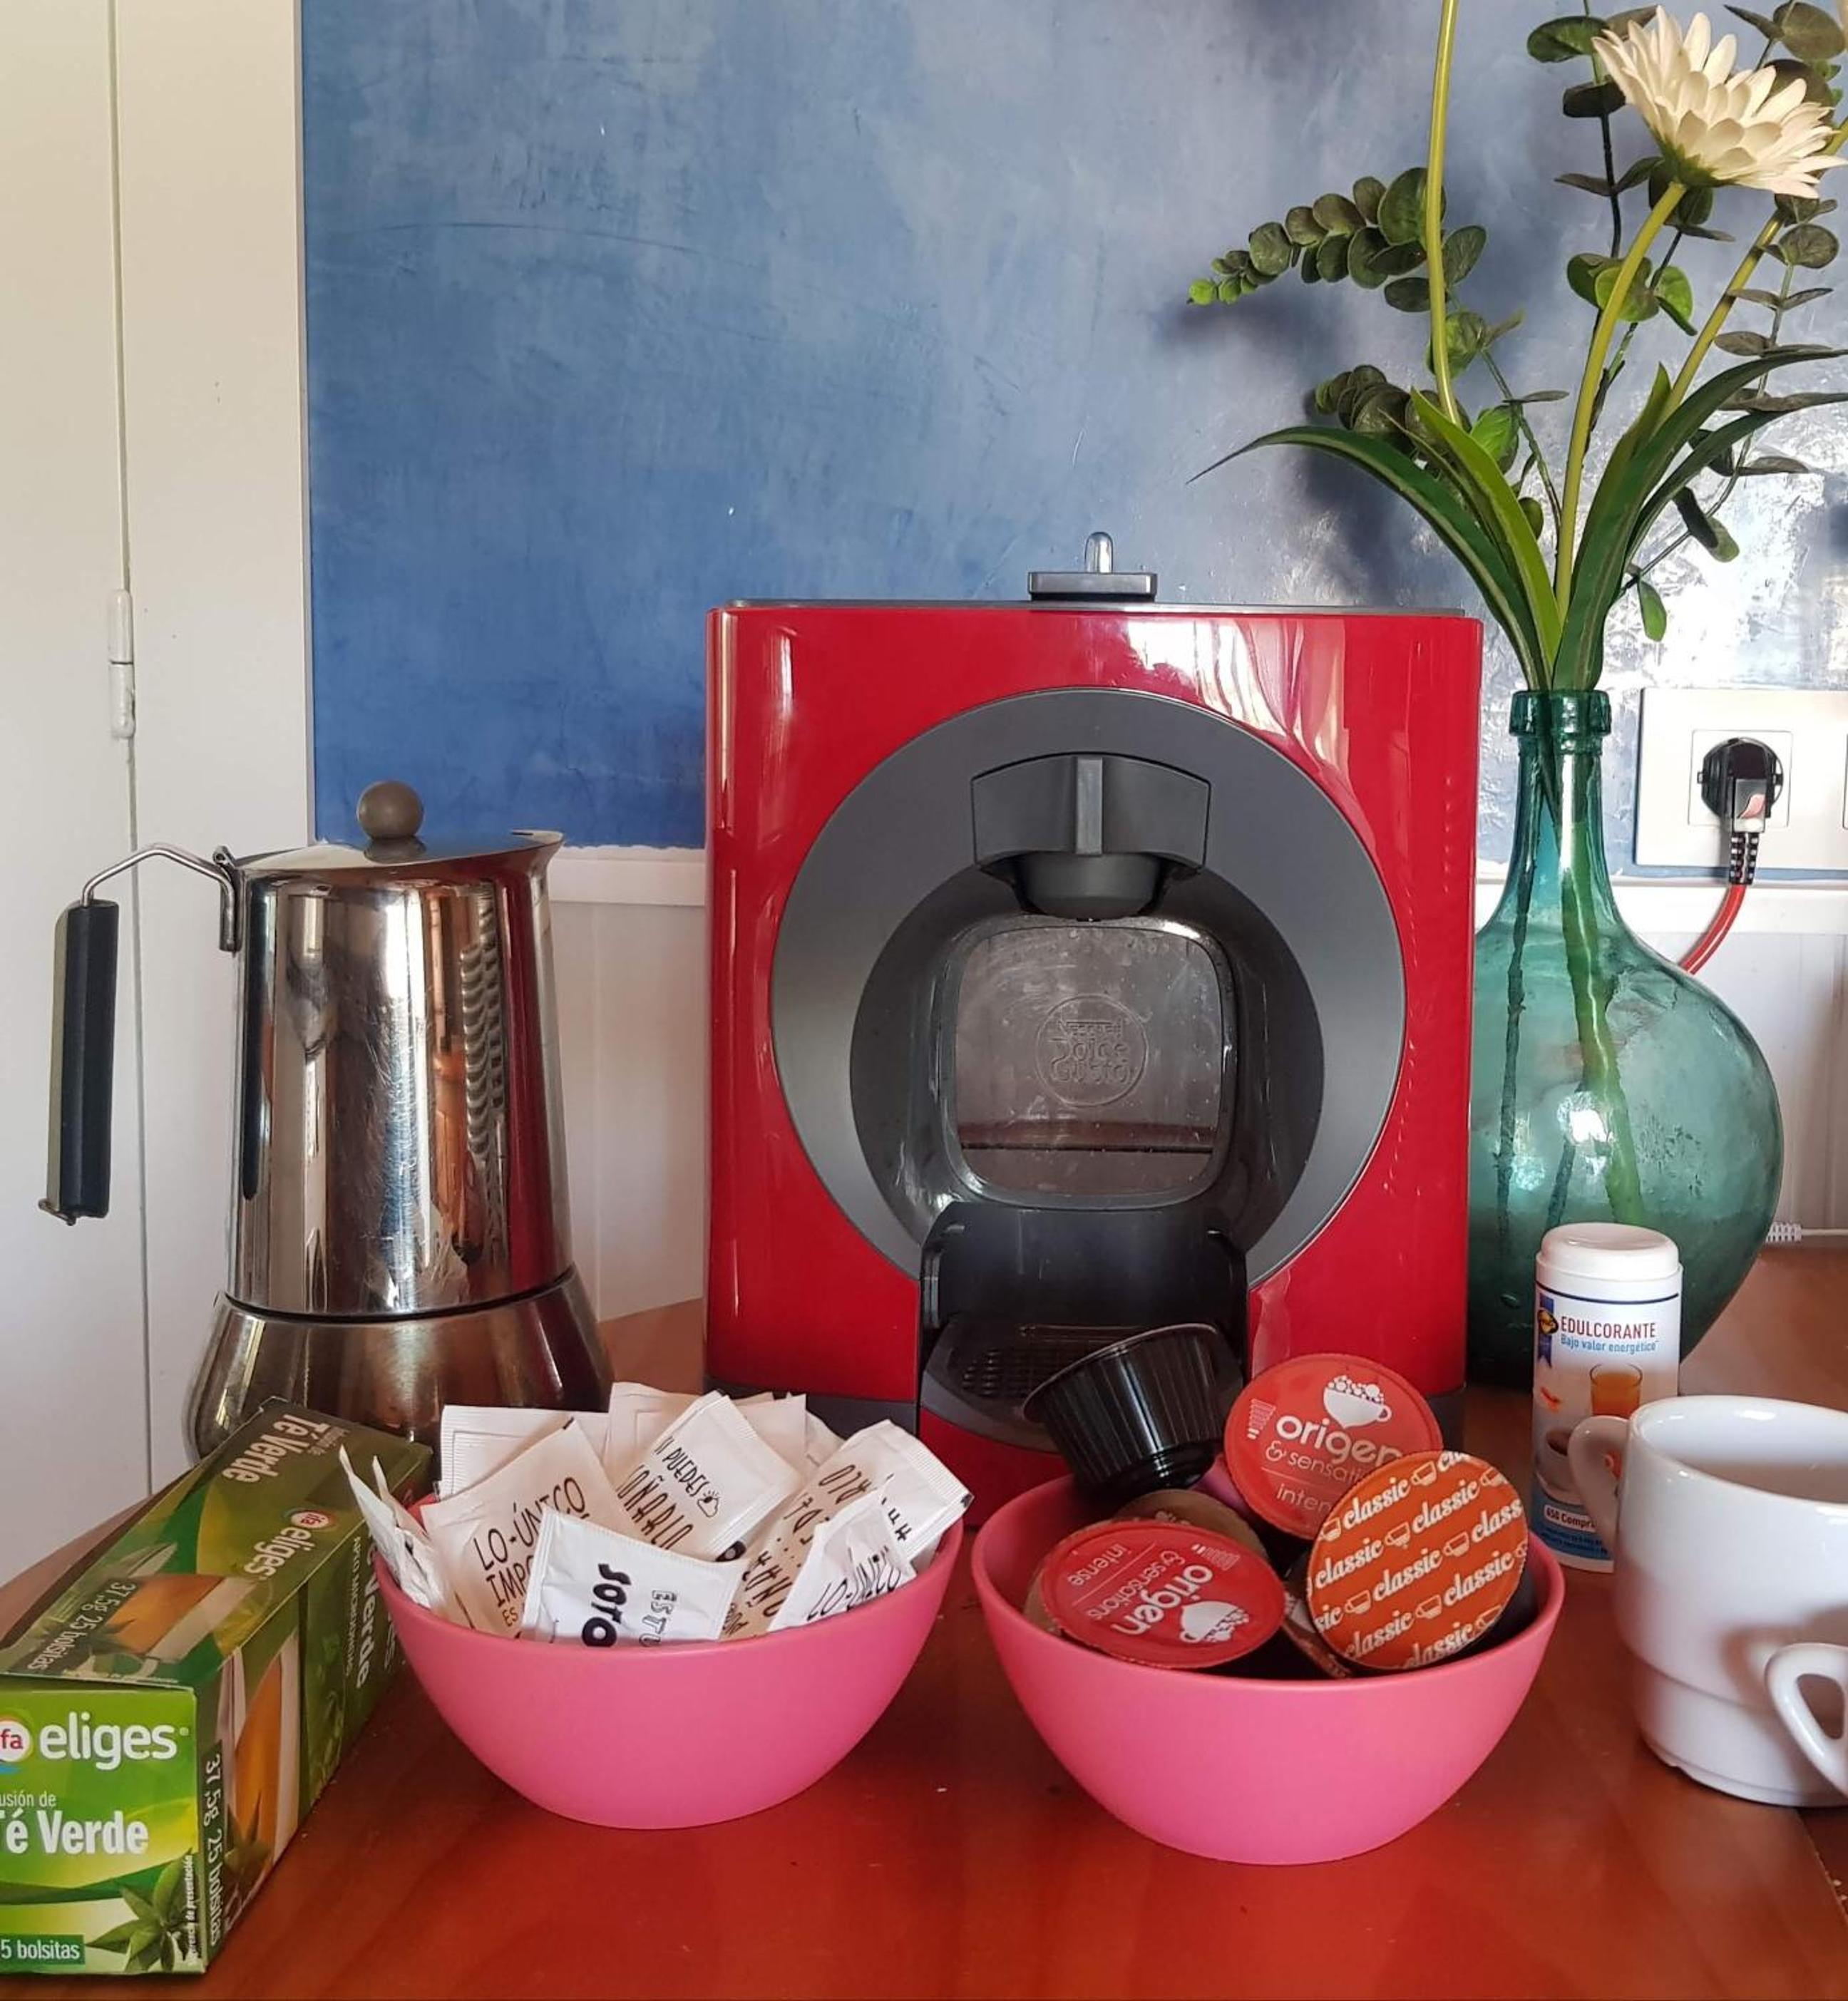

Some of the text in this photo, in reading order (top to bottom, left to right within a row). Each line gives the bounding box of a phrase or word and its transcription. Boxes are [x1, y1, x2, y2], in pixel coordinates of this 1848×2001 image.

[1560, 1335, 1656, 1354] Bajo valor energético
[1561, 1316, 1656, 1339] EDULCORANTE
[273, 1414, 330, 1440] Té
[222, 1434, 309, 1483] Verde
[662, 1447, 709, 1498] PUEDES
[1266, 1440, 1365, 1485] & sensati
[617, 1464, 694, 1553] OÑARLO
[1276, 1483, 1331, 1513] inten
[1343, 1476, 1411, 1530] classic
[243, 1527, 315, 1580] eliges
[1315, 1478, 1480, 1589] classic classic
[1372, 1547, 1443, 1602] classic
[1471, 1498, 1523, 1543] class
[1067, 1543, 1128, 1586] intense
[1087, 1561, 1167, 1620] sensations
[1111, 1564, 1213, 1635] origen
[1343, 1550, 1515, 1660] classic classic
[70, 1614, 103, 1630] 25
[356, 1572, 380, 1688] Verde
[502, 1607, 518, 1628] ES
[26, 1630, 87, 1671] bolsitas
[1405, 1621, 1474, 1669] classic
[0, 1712, 178, 1771] fa eliges
[0, 1791, 56, 1808] usión de
[36, 1810, 149, 1854] Verde
[207, 1828, 223, 1863] 25
[207, 1863, 225, 1946] bolsitas
[0, 1938, 81, 1960] 5 bolsitas
